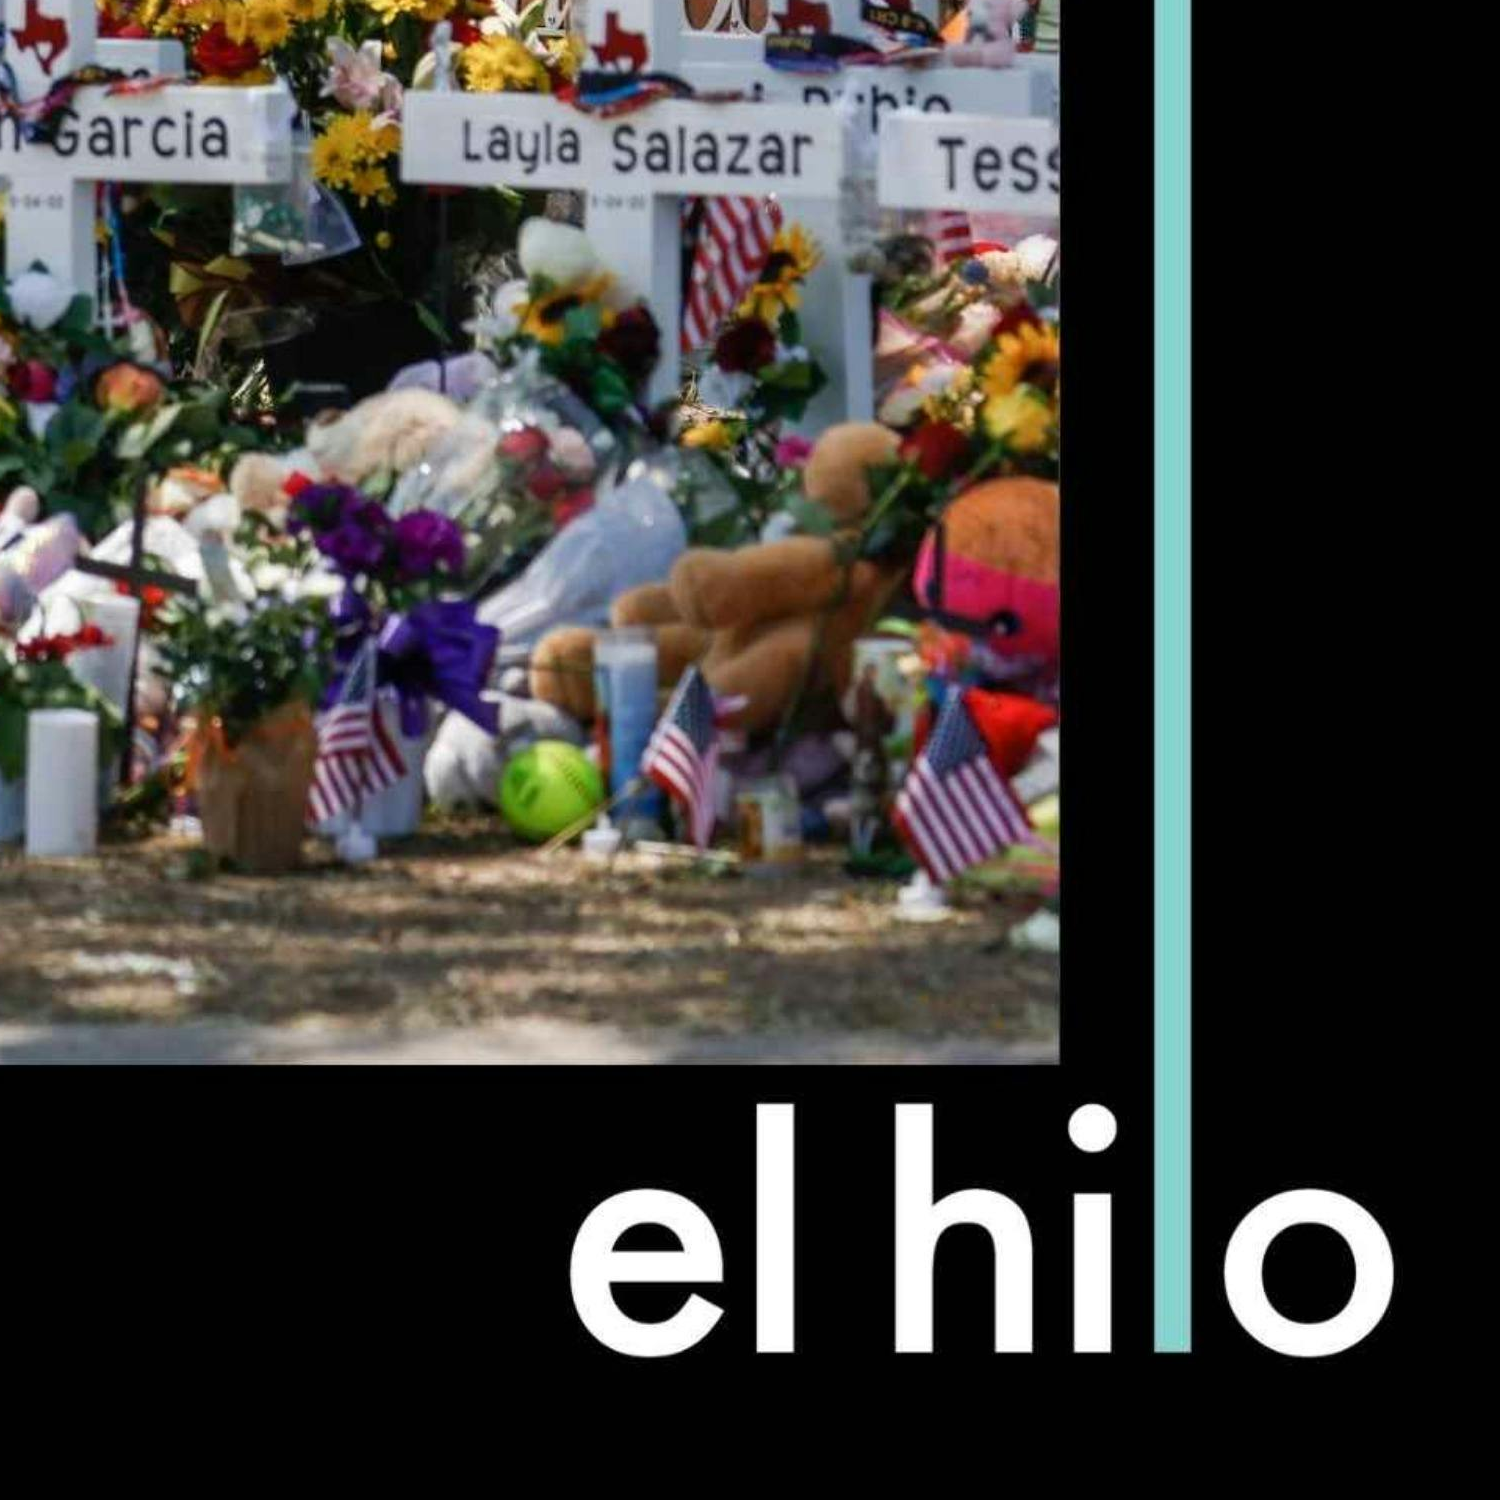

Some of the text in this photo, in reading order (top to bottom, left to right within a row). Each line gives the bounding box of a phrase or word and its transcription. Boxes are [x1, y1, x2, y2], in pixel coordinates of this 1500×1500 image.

[52, 107, 228, 159] Garcia
[462, 119, 813, 176] Layla Salazar
